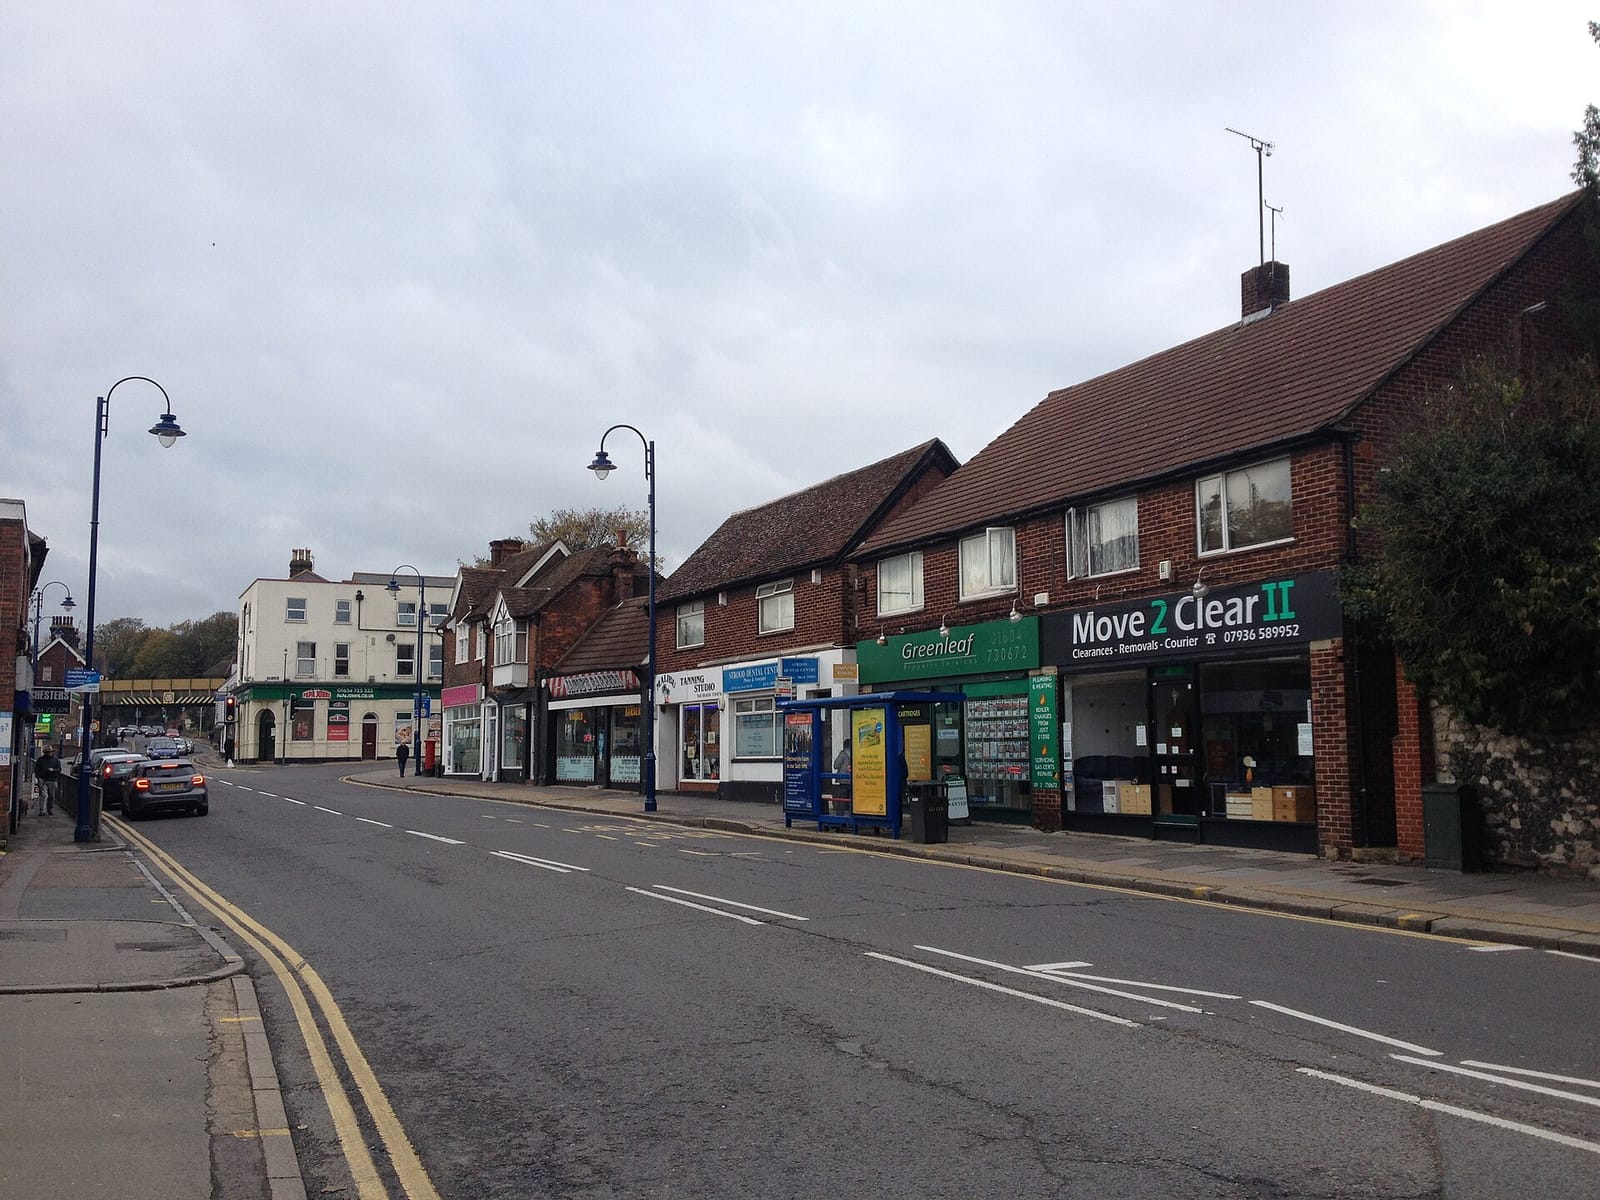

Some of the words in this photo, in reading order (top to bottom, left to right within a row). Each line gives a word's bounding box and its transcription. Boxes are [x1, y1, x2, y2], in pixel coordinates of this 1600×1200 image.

[1073, 610, 1145, 644] Move
[1151, 600, 1167, 634] 2
[1175, 595, 1259, 631] Clear
[902, 633, 975, 660] Greenleaf
[1072, 646, 1114, 660] Clearances
[1119, 640, 1159, 654] Removals
[1164, 635, 1199, 649] Courier
[1224, 628, 1257, 643] 07936
[1258, 623, 1300, 640] 589952
[987, 645, 1028, 665] 730672
[680, 675, 705, 686] TANNING
[693, 682, 716, 693] STUDIO
